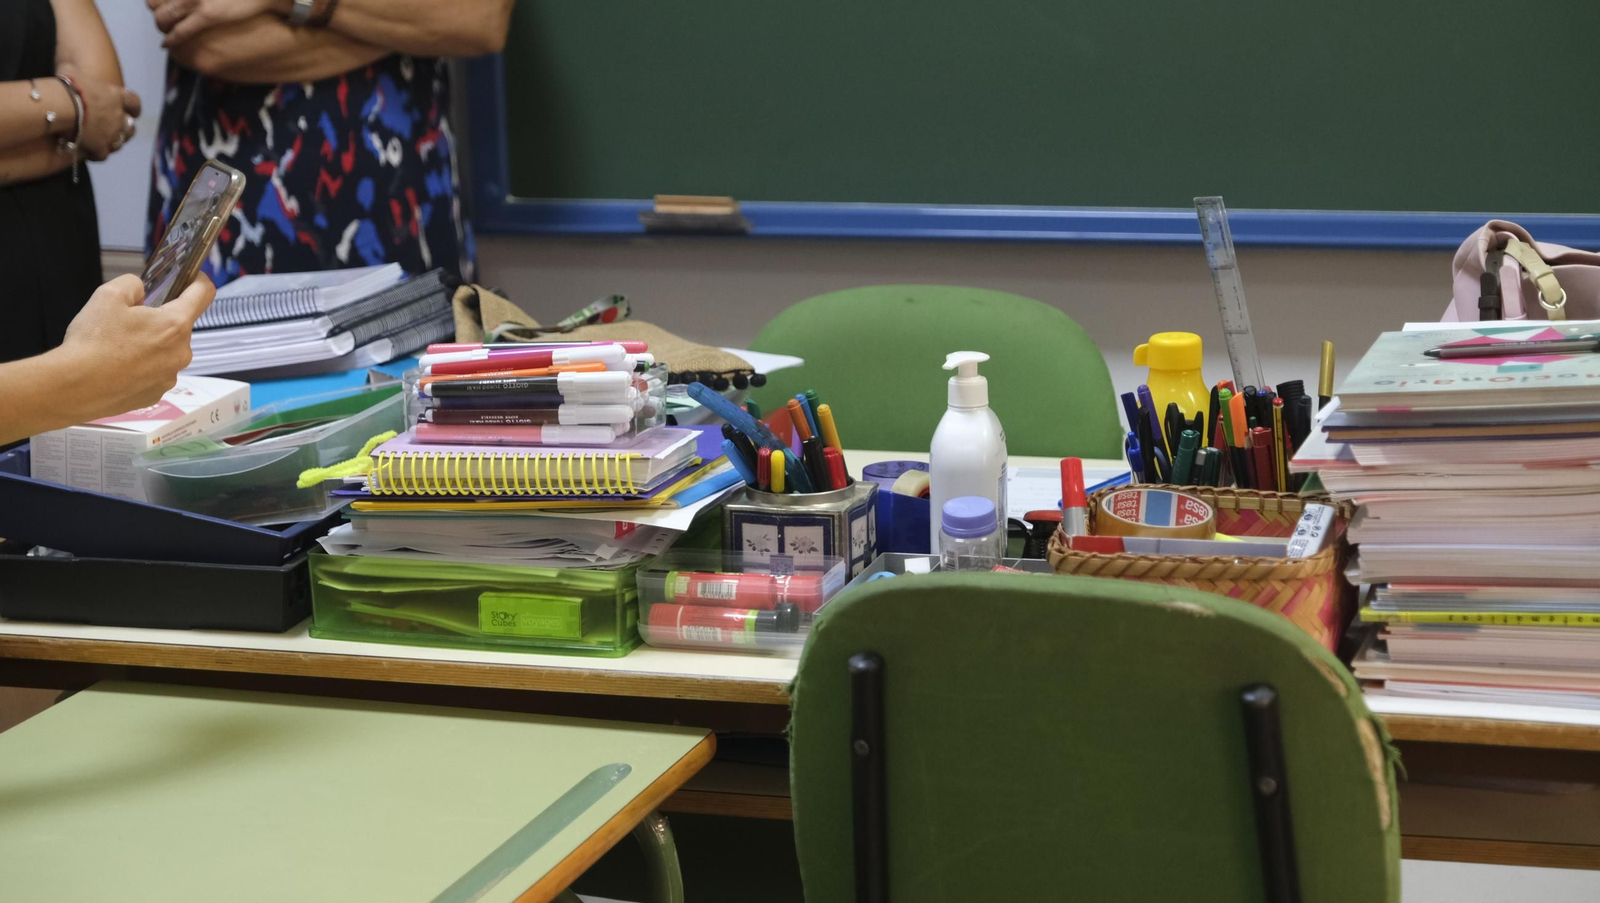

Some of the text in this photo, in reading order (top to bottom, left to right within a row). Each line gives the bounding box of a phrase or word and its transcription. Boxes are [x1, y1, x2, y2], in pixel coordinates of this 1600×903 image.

[1118, 491, 1138, 500] tesa
[1117, 500, 1138, 509] tesa
[1184, 499, 1208, 519] tesa
[491, 611, 518, 621] Story
[491, 619, 517, 627] Cubes
